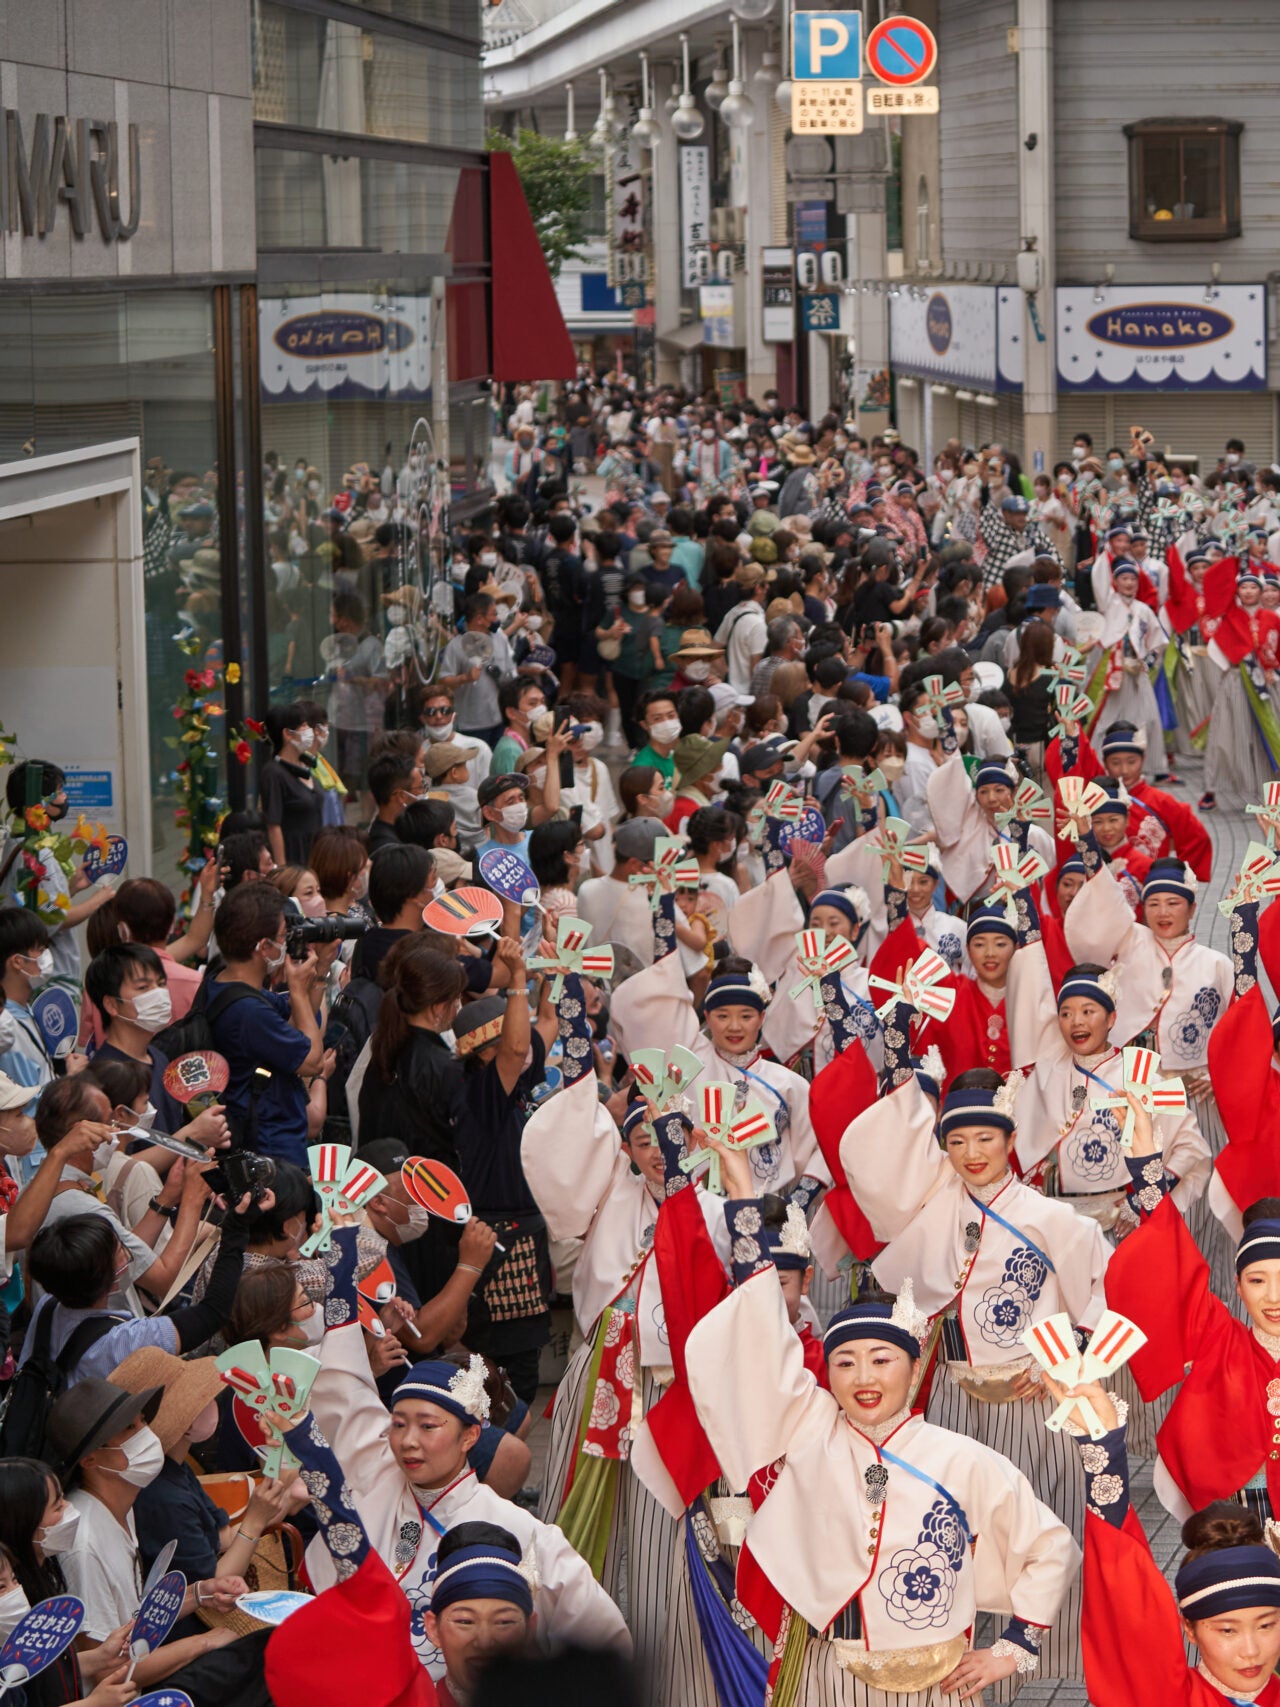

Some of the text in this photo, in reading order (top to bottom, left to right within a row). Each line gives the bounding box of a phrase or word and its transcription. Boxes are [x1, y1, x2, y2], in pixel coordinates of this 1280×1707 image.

[810, 18, 849, 74] P
[1107, 317, 1213, 337] Hanako
[24, 1613, 77, 1635] #おかえり
[143, 1604, 170, 1627] よさこい
[15, 1631, 61, 1650] よさこい
